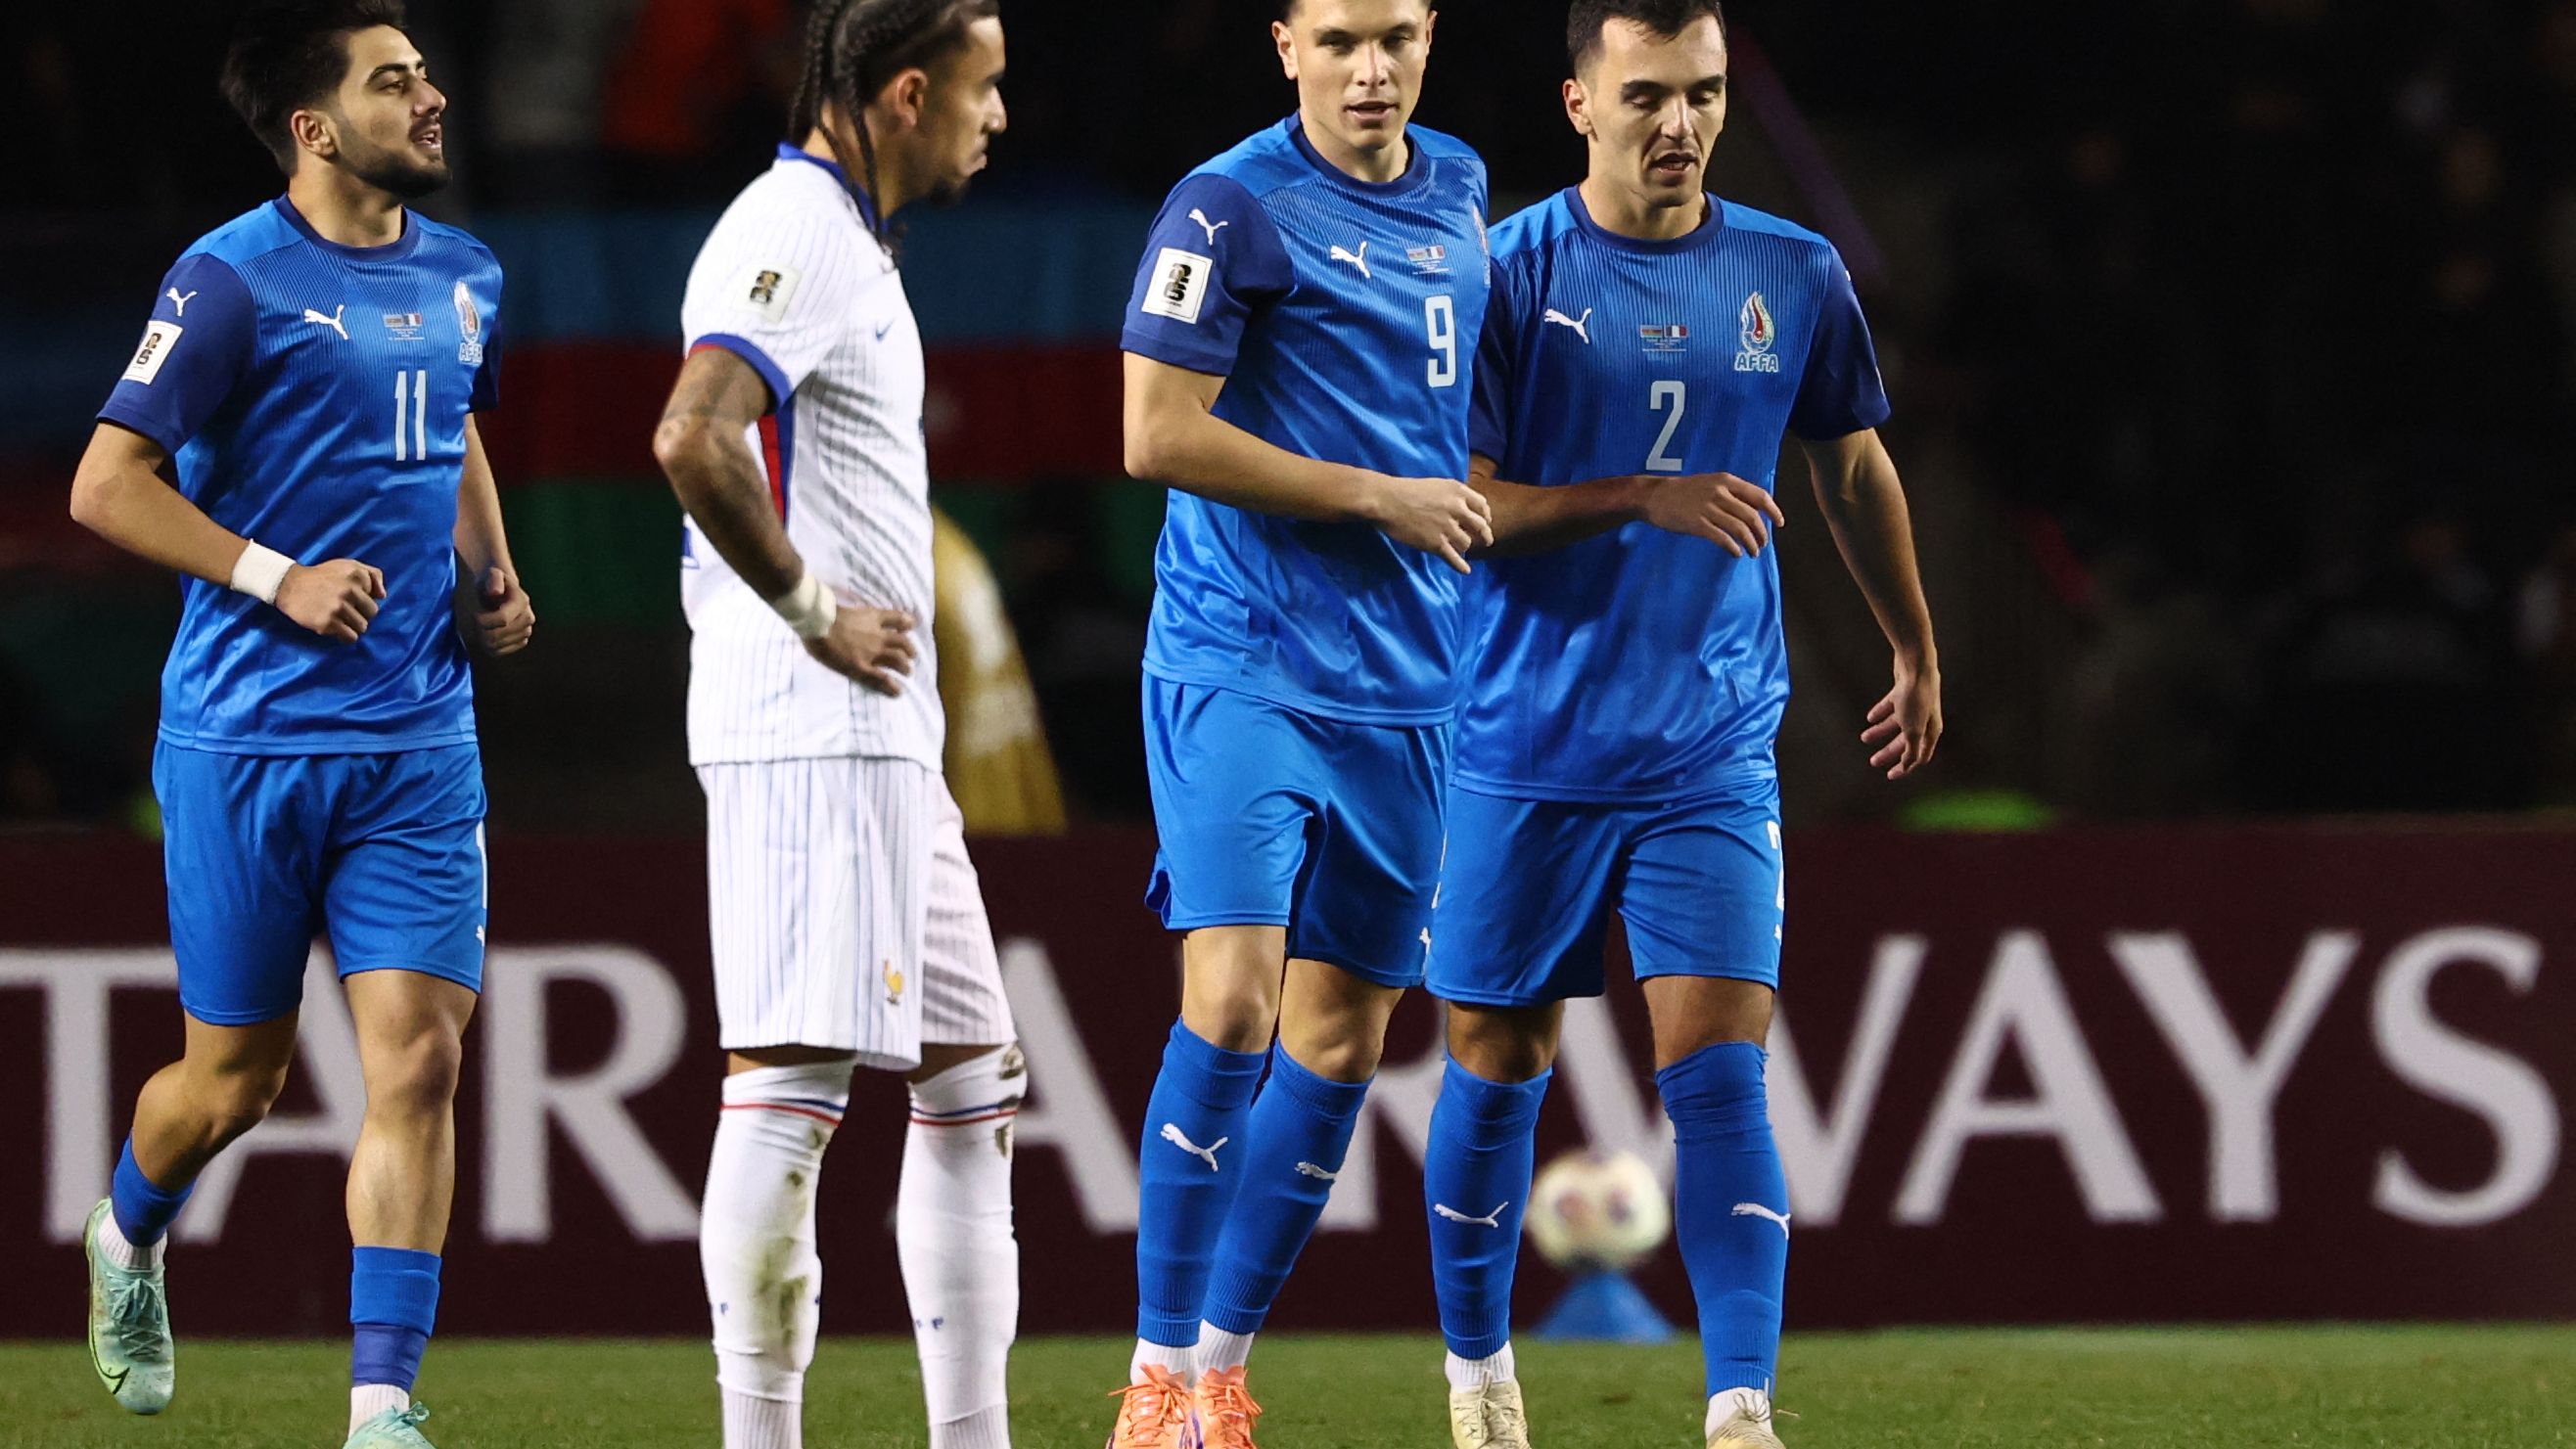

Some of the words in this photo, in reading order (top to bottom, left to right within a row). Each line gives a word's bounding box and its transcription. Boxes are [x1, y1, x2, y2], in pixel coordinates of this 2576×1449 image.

[1425, 294, 1456, 388] 9
[1733, 352, 1779, 373] AFFA
[393, 370, 427, 462] 11
[1645, 380, 1686, 472] 2
